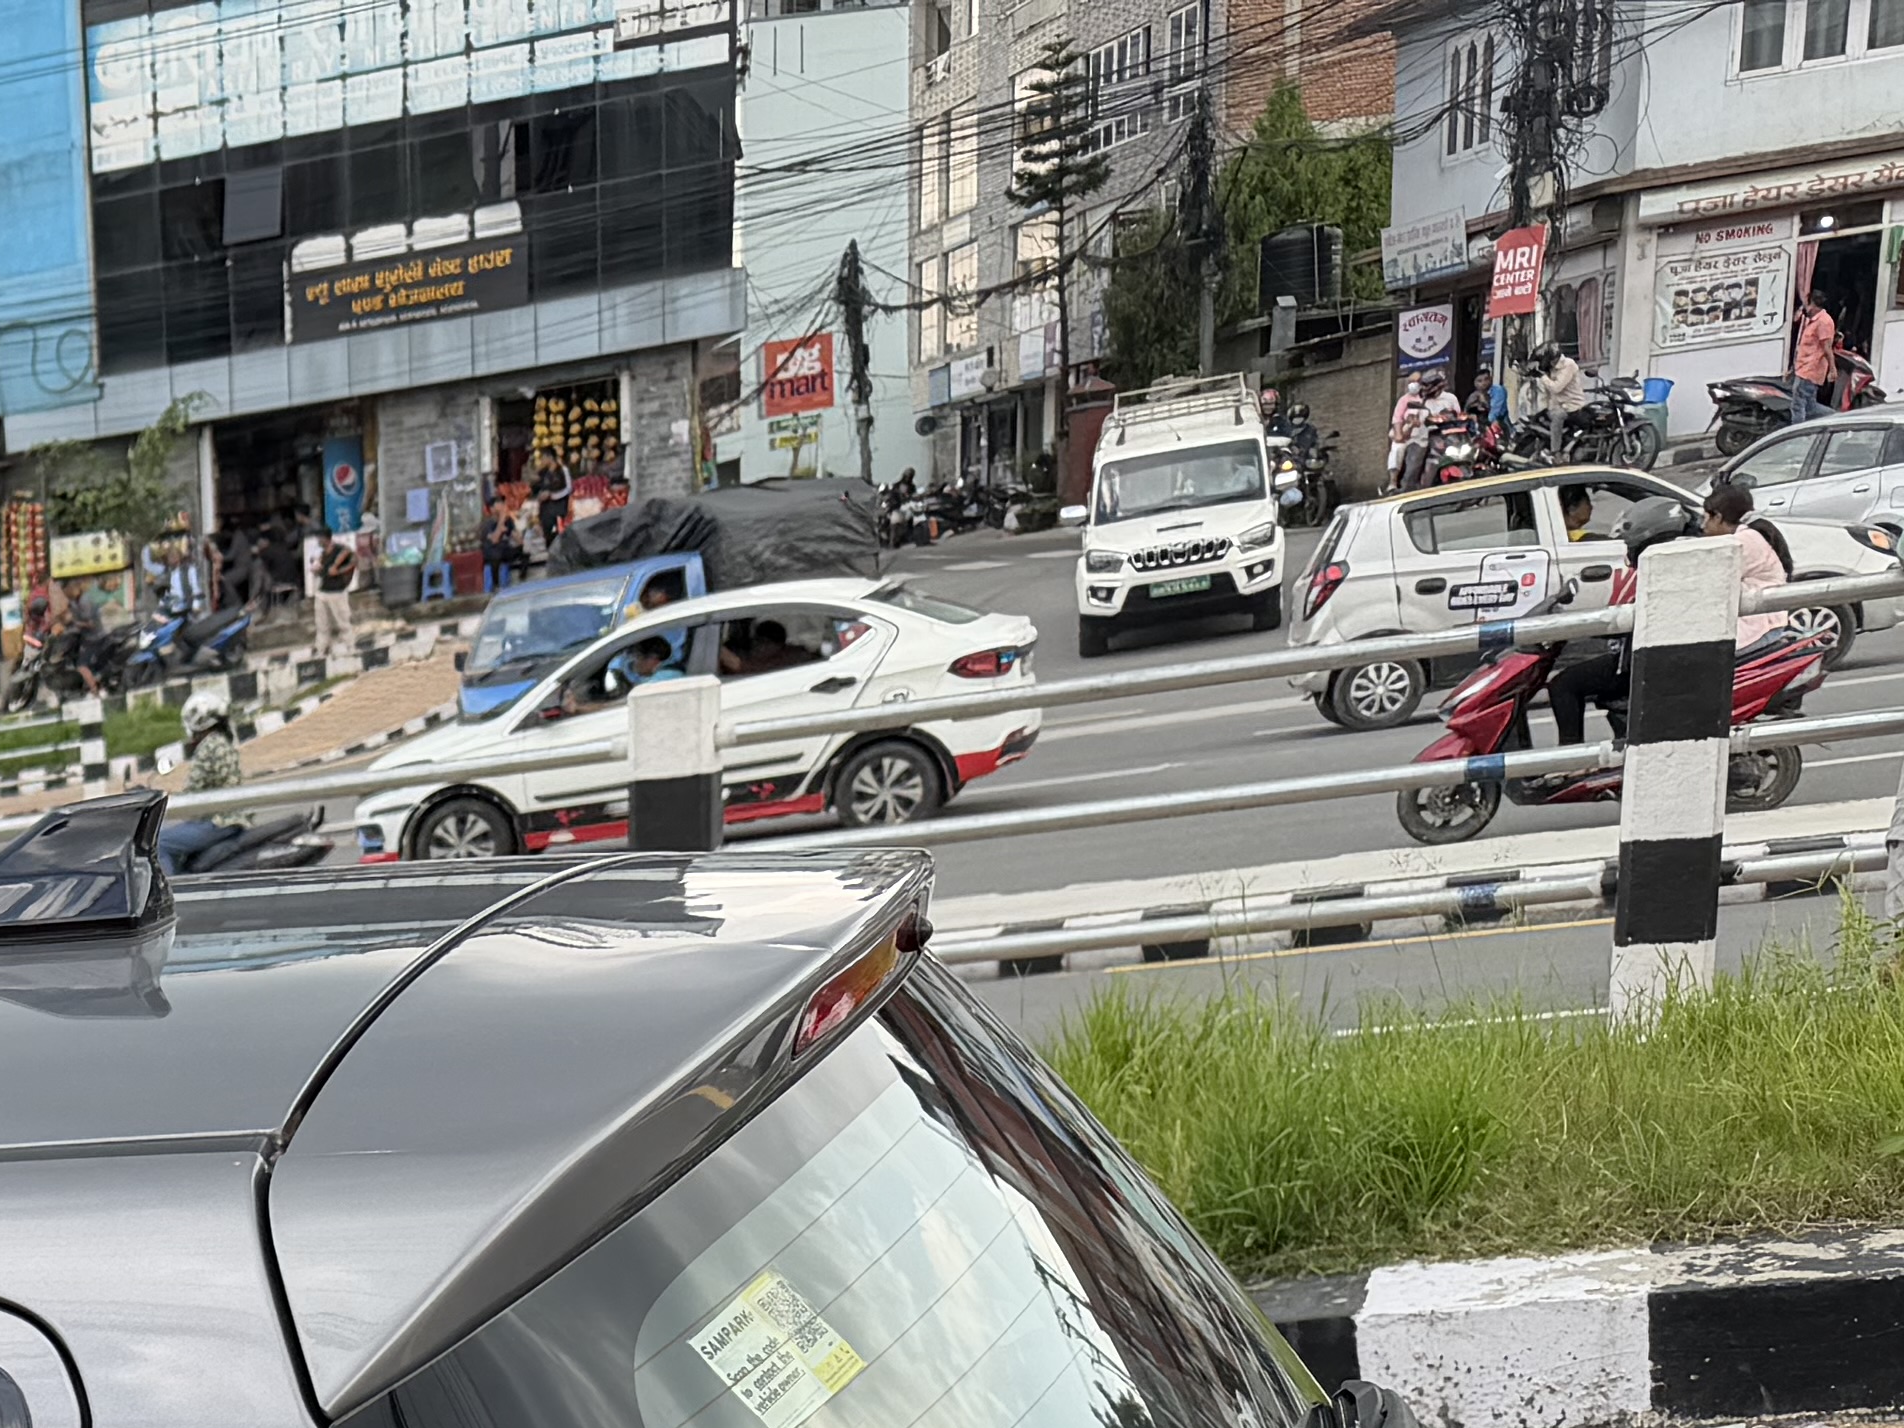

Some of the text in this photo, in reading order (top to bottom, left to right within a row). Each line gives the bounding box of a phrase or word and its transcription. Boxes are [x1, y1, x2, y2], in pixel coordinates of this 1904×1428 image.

[1678, 192, 1738, 216] पूजा
[1742, 183, 1804, 209] हेयर
[1696, 223, 1774, 244] NO SMOKING
[1495, 244, 1538, 273] MRI
[1493, 269, 1535, 287] CENTER
[769, 369, 829, 399] mart
[700, 1308, 754, 1361] SAMPARK
